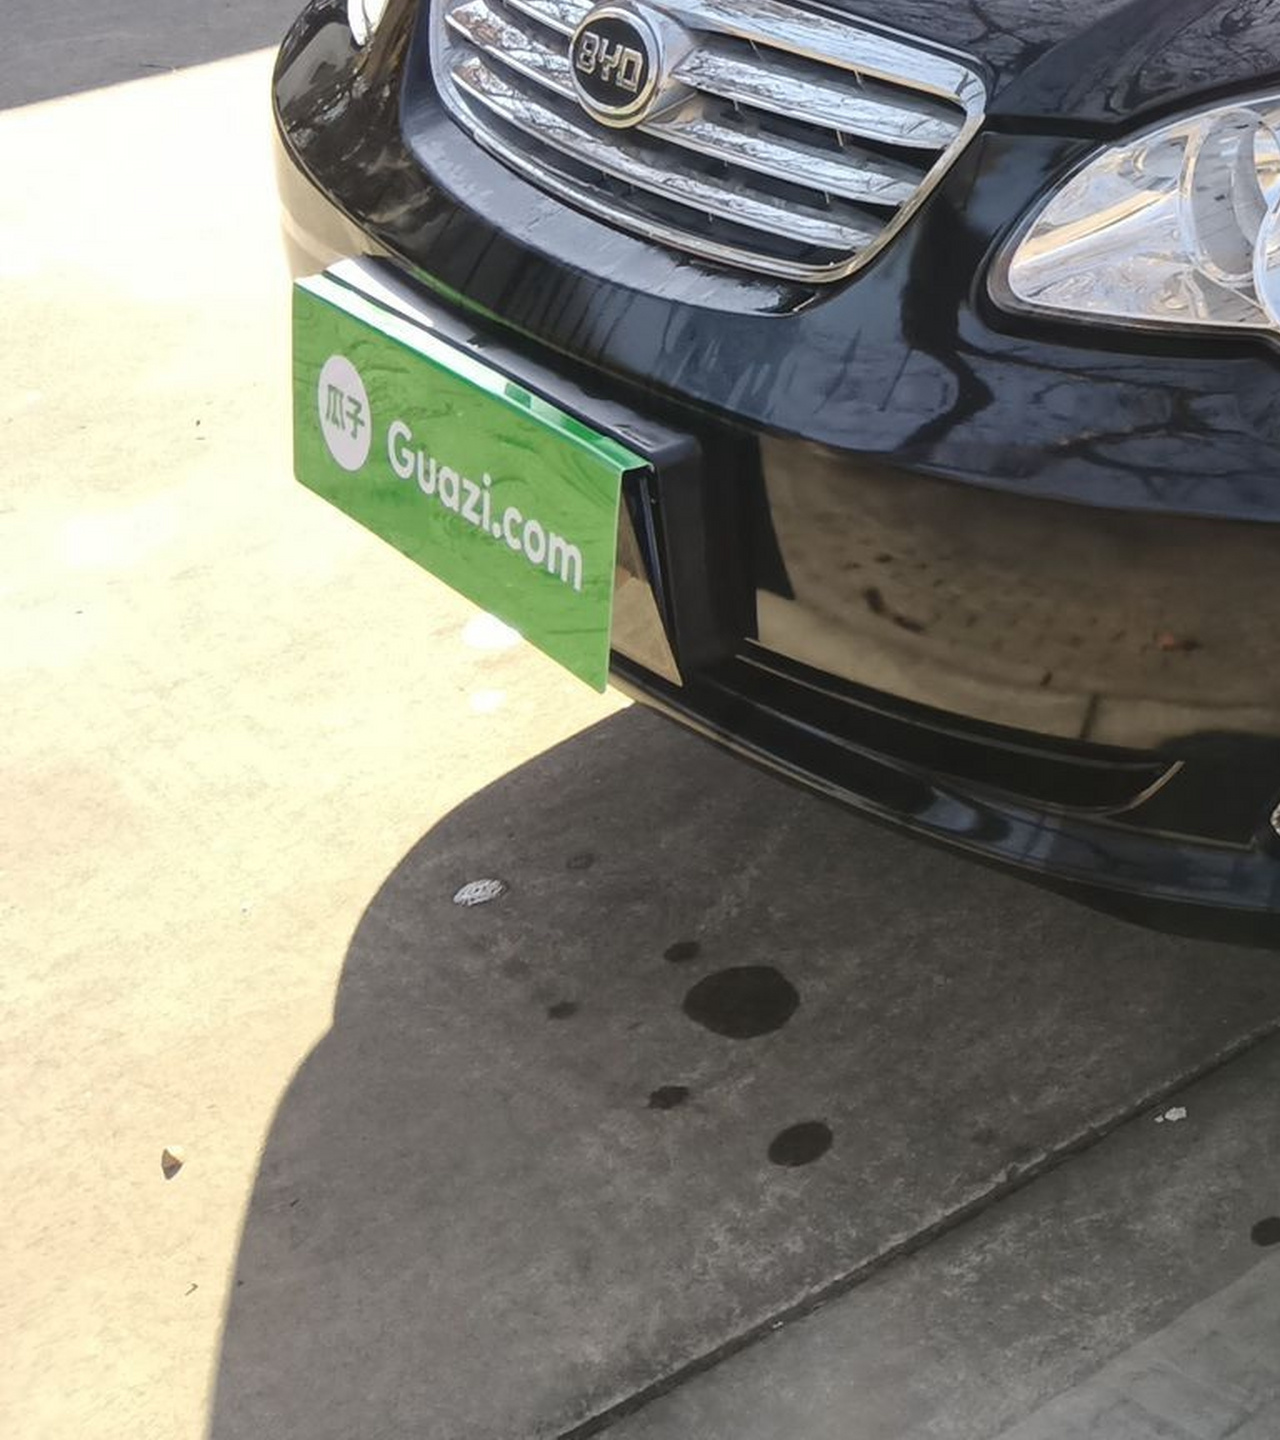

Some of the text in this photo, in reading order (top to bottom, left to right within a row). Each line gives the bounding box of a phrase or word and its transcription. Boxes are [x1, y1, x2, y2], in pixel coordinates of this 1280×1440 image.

[576, 31, 643, 93] BYD
[324, 384, 367, 440] 瓜子
[387, 420, 584, 592] Guazi.com
